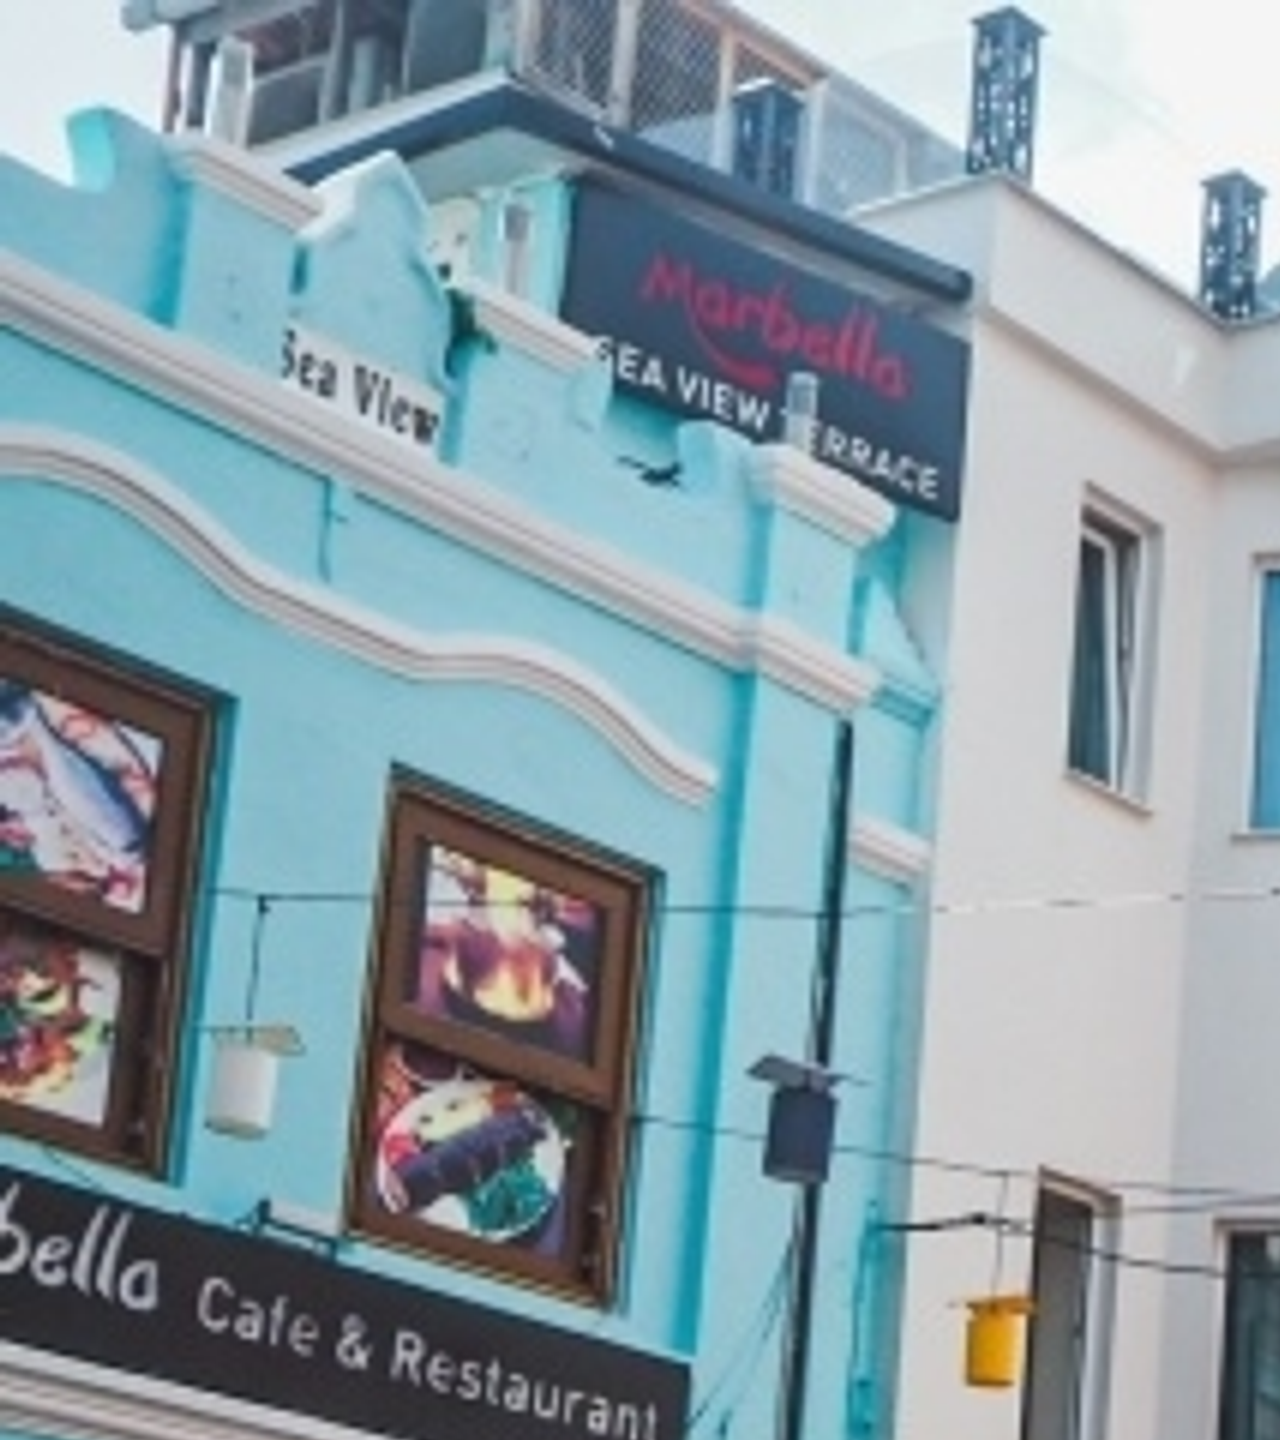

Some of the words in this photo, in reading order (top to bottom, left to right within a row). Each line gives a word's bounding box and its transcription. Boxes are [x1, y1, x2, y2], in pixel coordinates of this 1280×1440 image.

[281, 327, 338, 398] Sea
[354, 362, 440, 446] View
[596, 335, 668, 393] SEA
[676, 364, 771, 432] VIEW
[780, 405, 939, 501] ERRACE
[197, 1276, 320, 1356] Cafe
[336, 1316, 374, 1370] &
